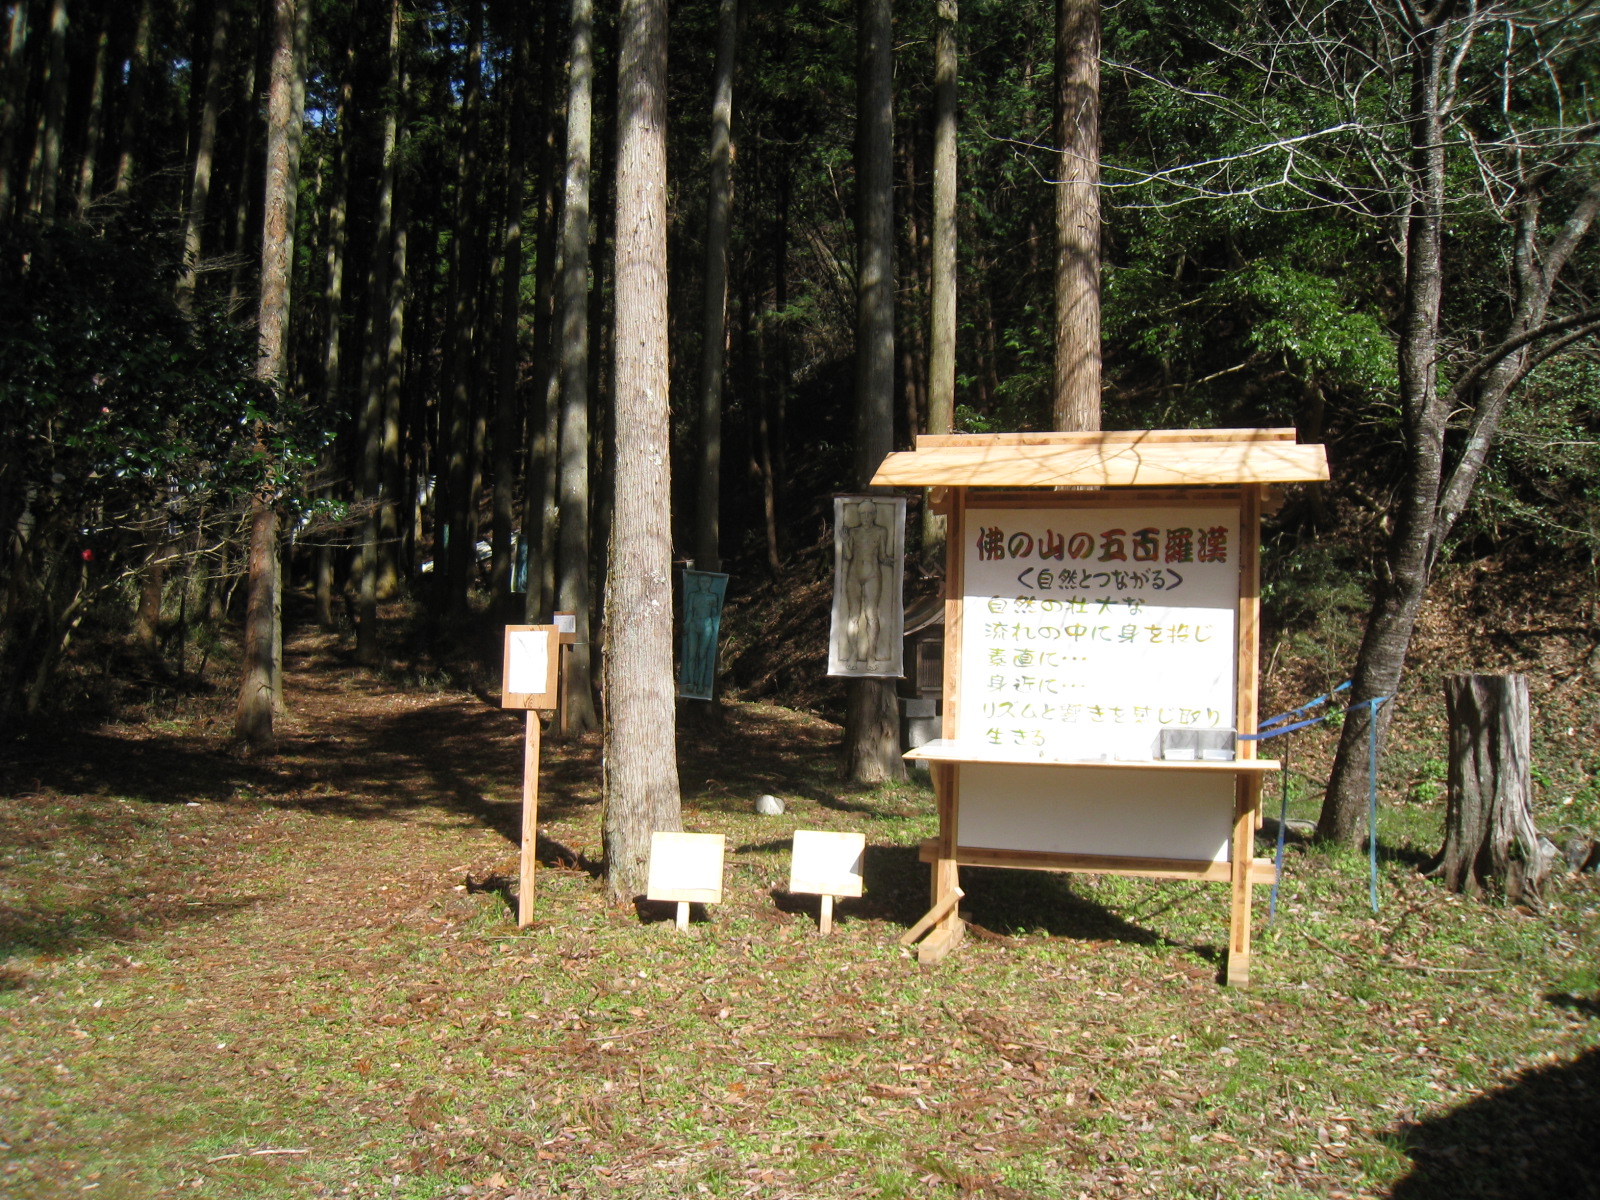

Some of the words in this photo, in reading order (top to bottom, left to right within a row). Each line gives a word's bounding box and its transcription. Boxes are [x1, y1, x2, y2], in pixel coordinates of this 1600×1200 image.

[977, 526, 1228, 563] 佛の山の五百羅漢
[988, 595, 1145, 615] 自然の壮大な
[984, 622, 1212, 643] 流れの中に身を投じ
[985, 728, 1045, 745] 生きる
